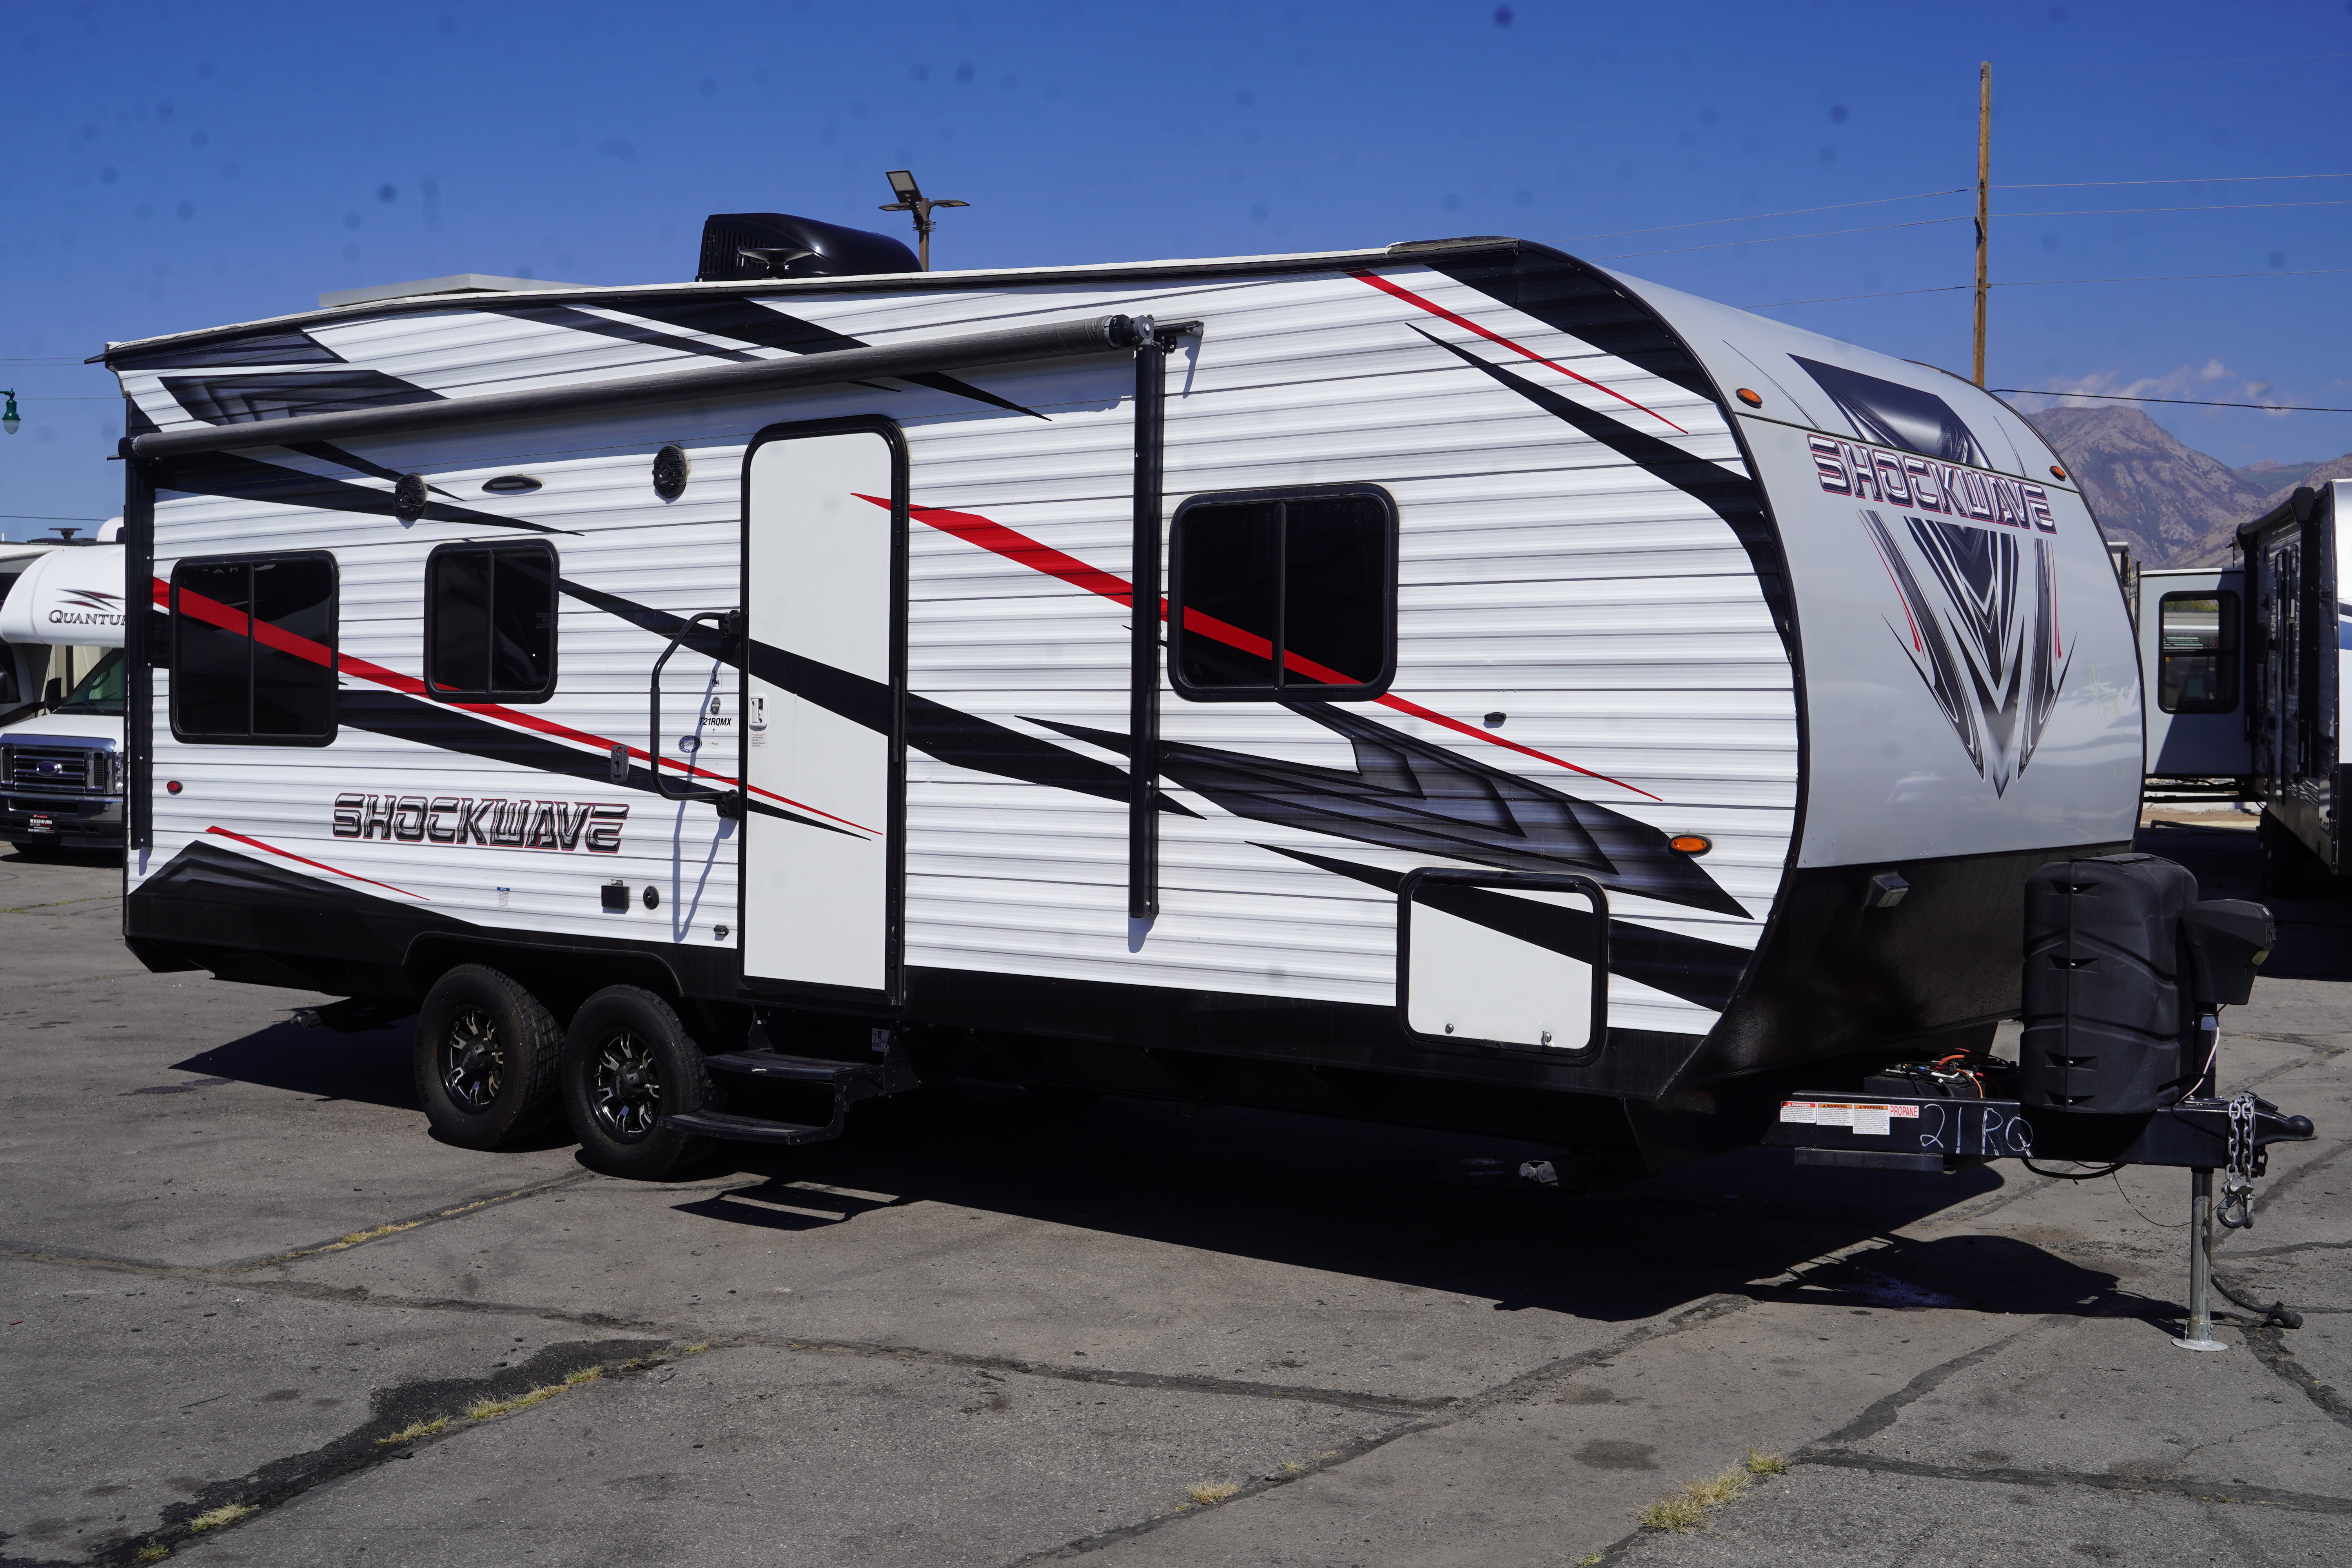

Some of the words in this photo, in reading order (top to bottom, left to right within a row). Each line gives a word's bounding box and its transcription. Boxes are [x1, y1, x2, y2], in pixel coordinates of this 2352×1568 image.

[1807, 434, 2057, 534] SHOCKWAVE
[699, 717, 732, 726] T21RQMX
[333, 793, 630, 854] SHOCKWAVE
[1890, 1106, 1918, 1117] PROPANE
